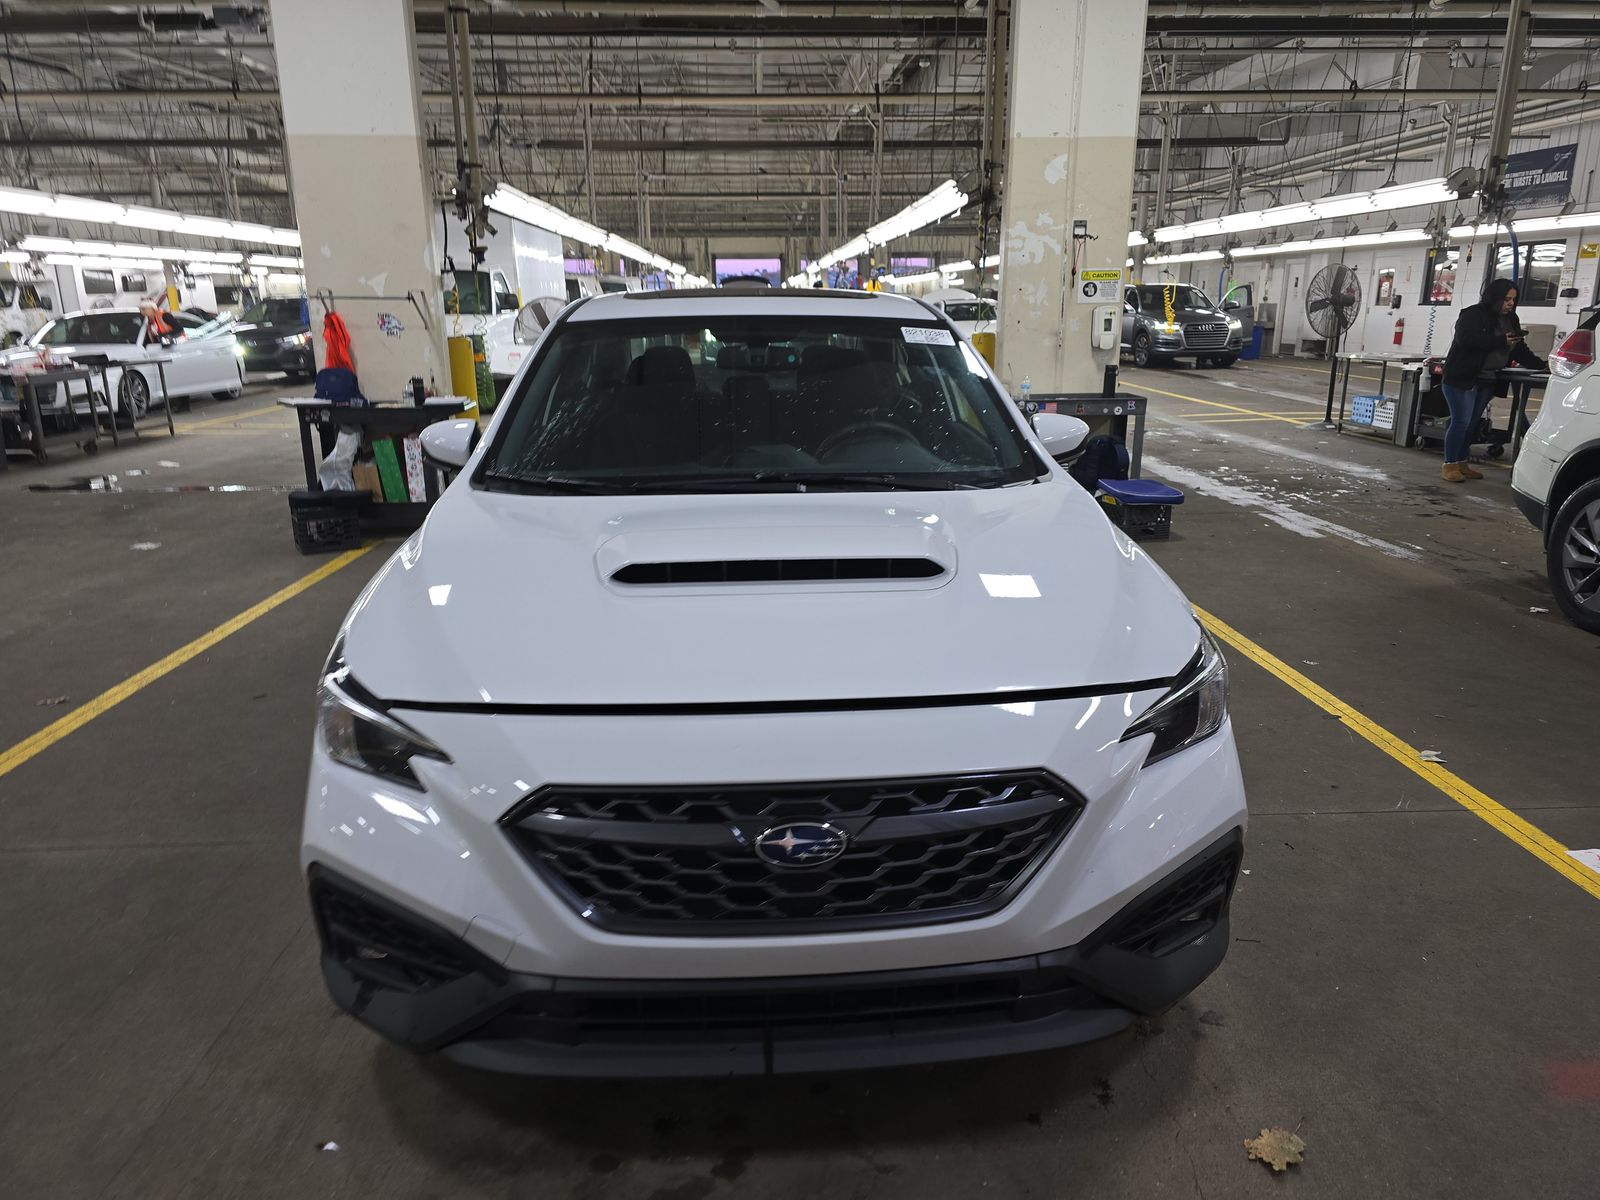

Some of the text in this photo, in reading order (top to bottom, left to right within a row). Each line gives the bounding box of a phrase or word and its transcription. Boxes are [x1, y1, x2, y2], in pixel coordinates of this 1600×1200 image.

[1513, 176, 1533, 187] WASTE
[1533, 174, 1541, 184] TO
[1542, 170, 1568, 183] LANDFILL
